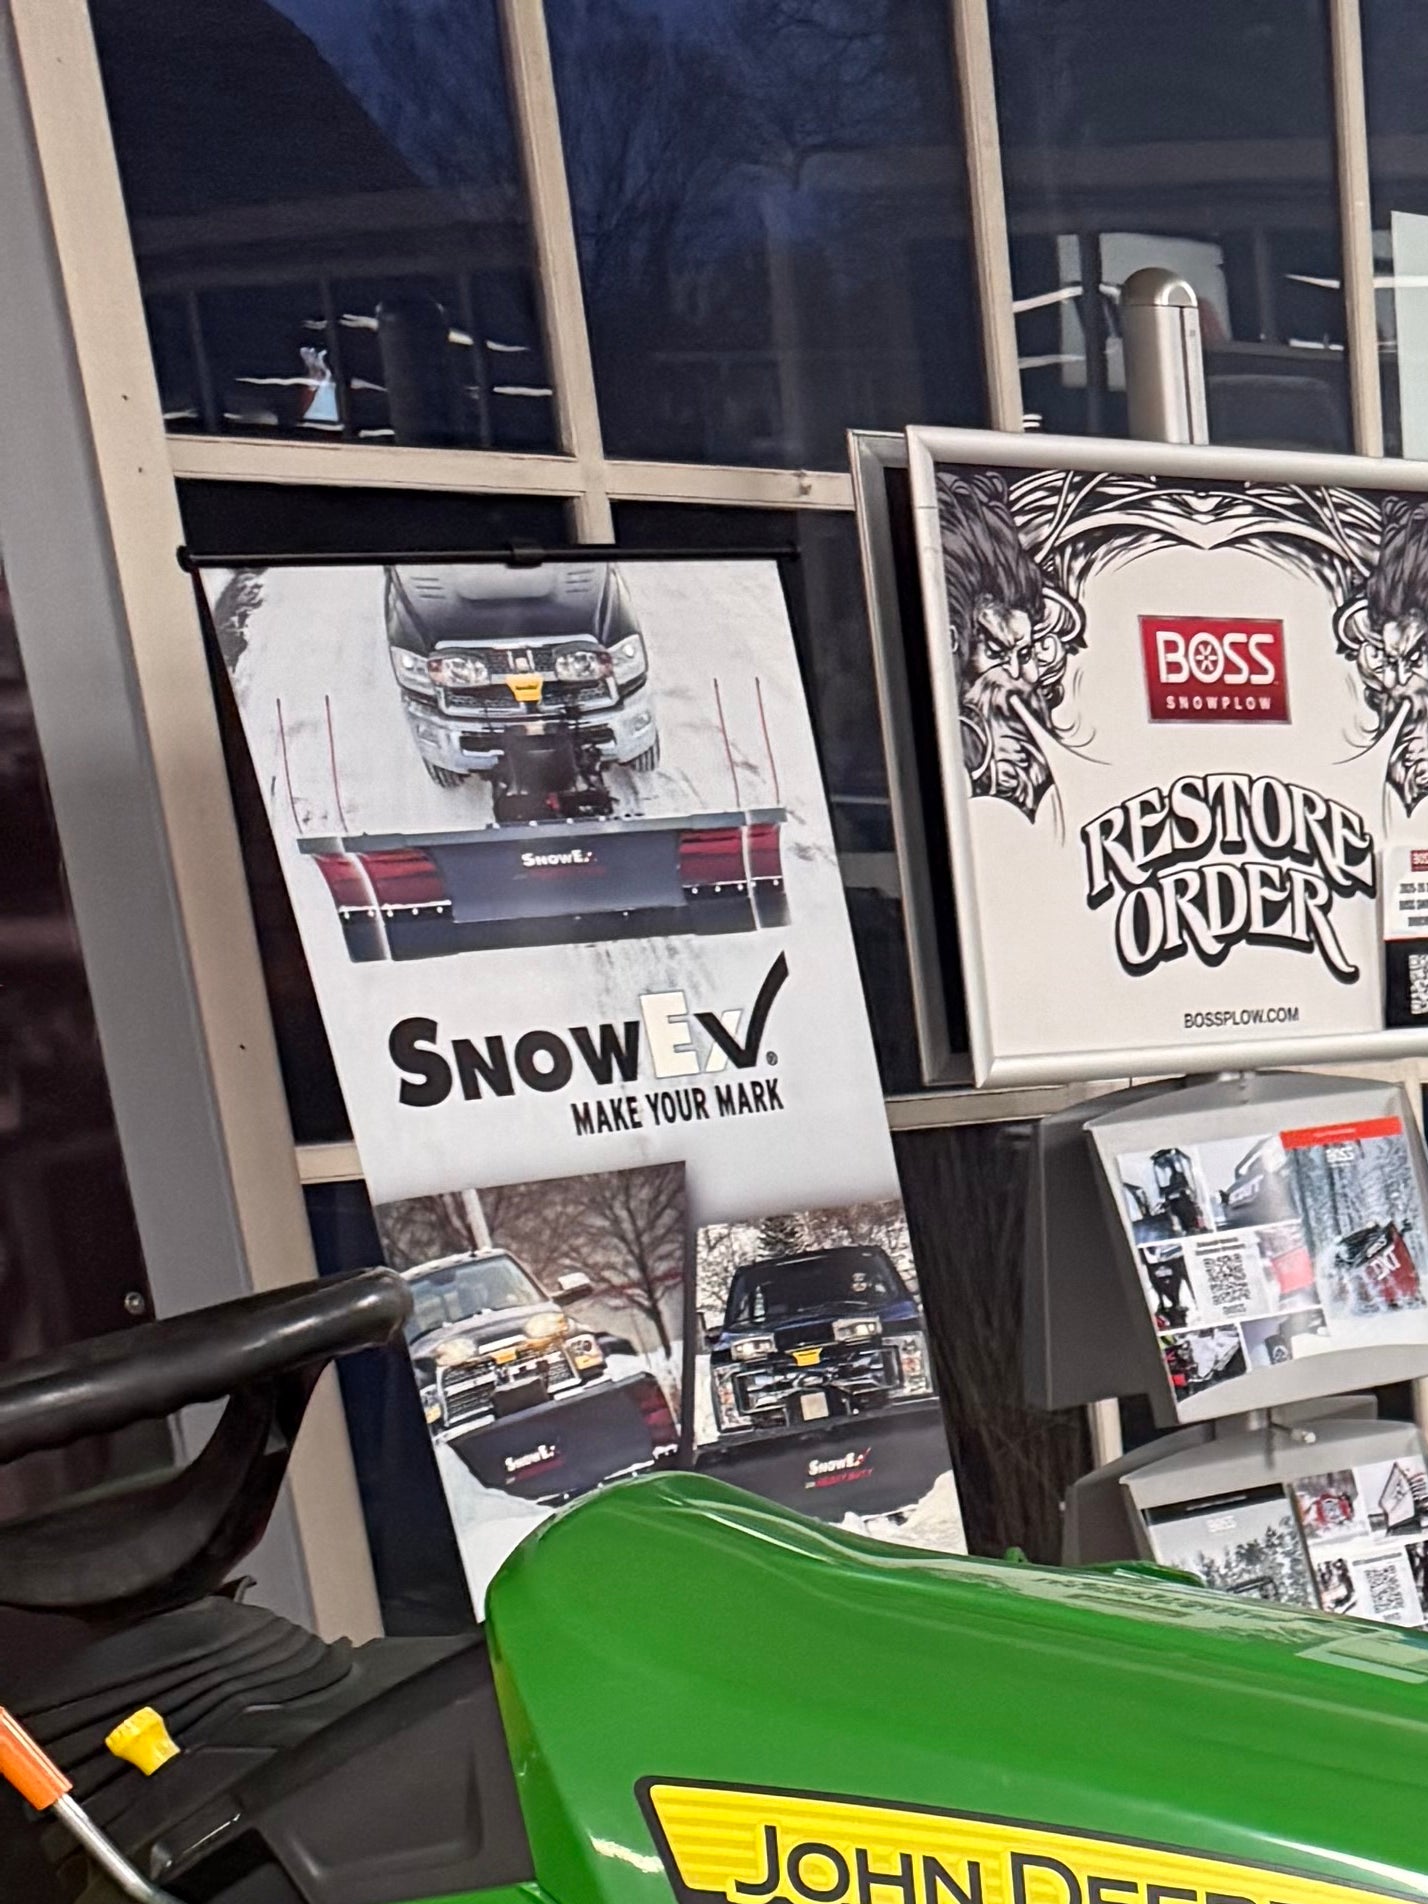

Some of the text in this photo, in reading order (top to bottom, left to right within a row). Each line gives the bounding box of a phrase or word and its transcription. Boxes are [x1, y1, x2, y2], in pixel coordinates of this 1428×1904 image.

[1156, 631, 1278, 686] BOSS
[1167, 695, 1272, 711] SNOWPLOW
[1081, 773, 1376, 910] RESTORE
[1115, 863, 1360, 984] ORDER
[1184, 1005, 1300, 1029] BOSSPLOW.COM
[571, 1077, 784, 1136] MAKE YOUR MARK
